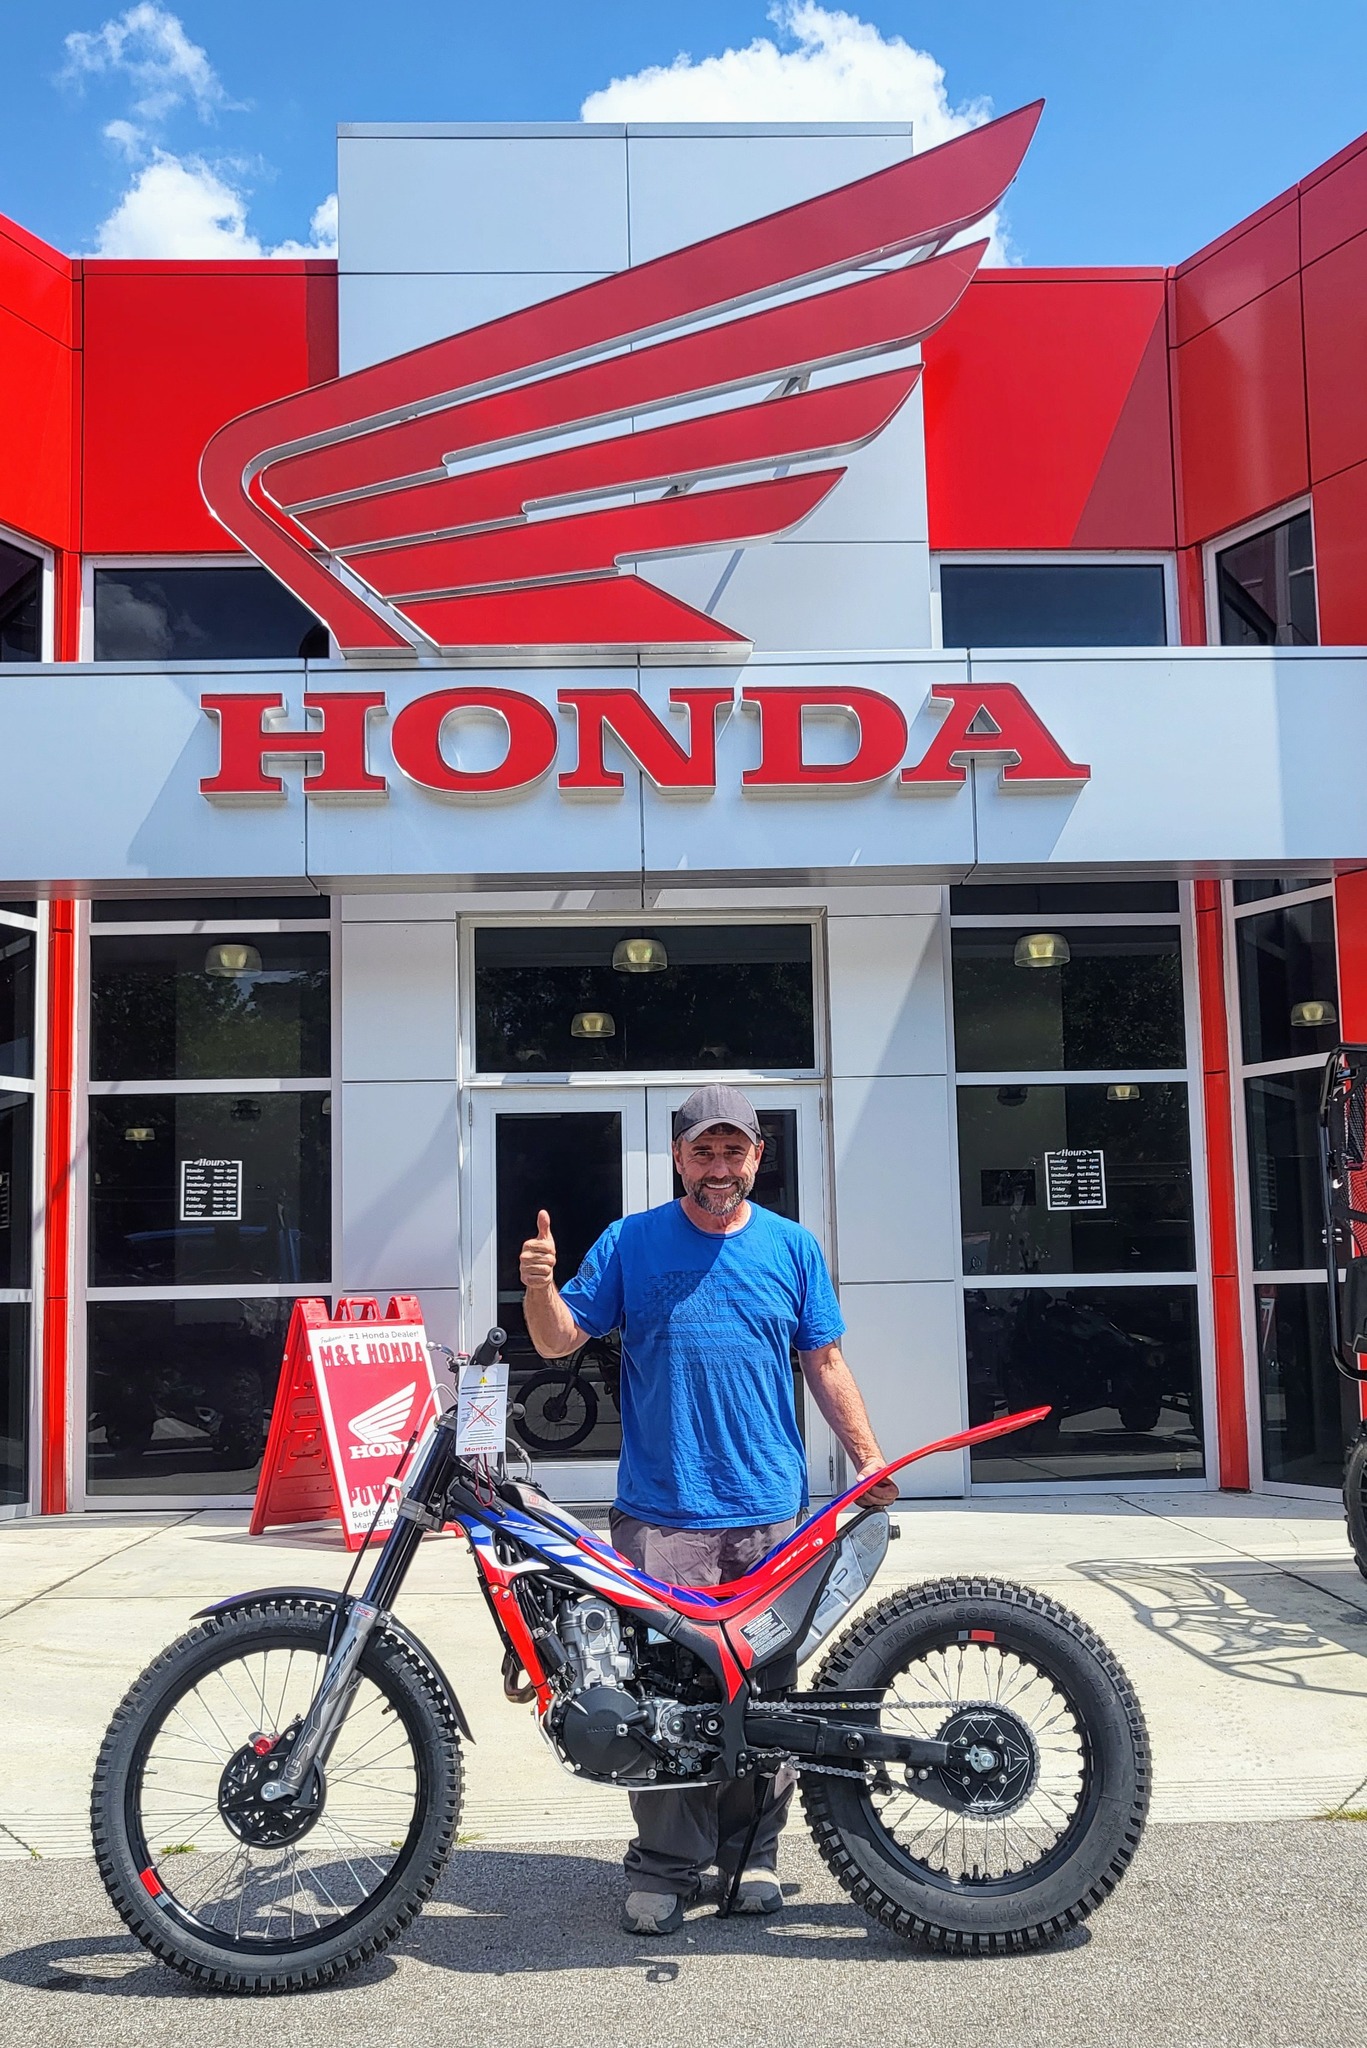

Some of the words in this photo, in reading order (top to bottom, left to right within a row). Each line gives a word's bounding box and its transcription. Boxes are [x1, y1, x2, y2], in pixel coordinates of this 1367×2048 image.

[200, 684, 1091, 796] HONDA
[199, 1158, 225, 1166] Hours
[348, 1332, 359, 1340] #1
[362, 1331, 389, 1340] Honda
[391, 1330, 419, 1339] Dealer!
[366, 1341, 424, 1365] HONDA
[348, 1441, 419, 1459] HOND
[352, 1508, 389, 1518] Bedfod,
[882, 1610, 938, 1651] TRIAL
